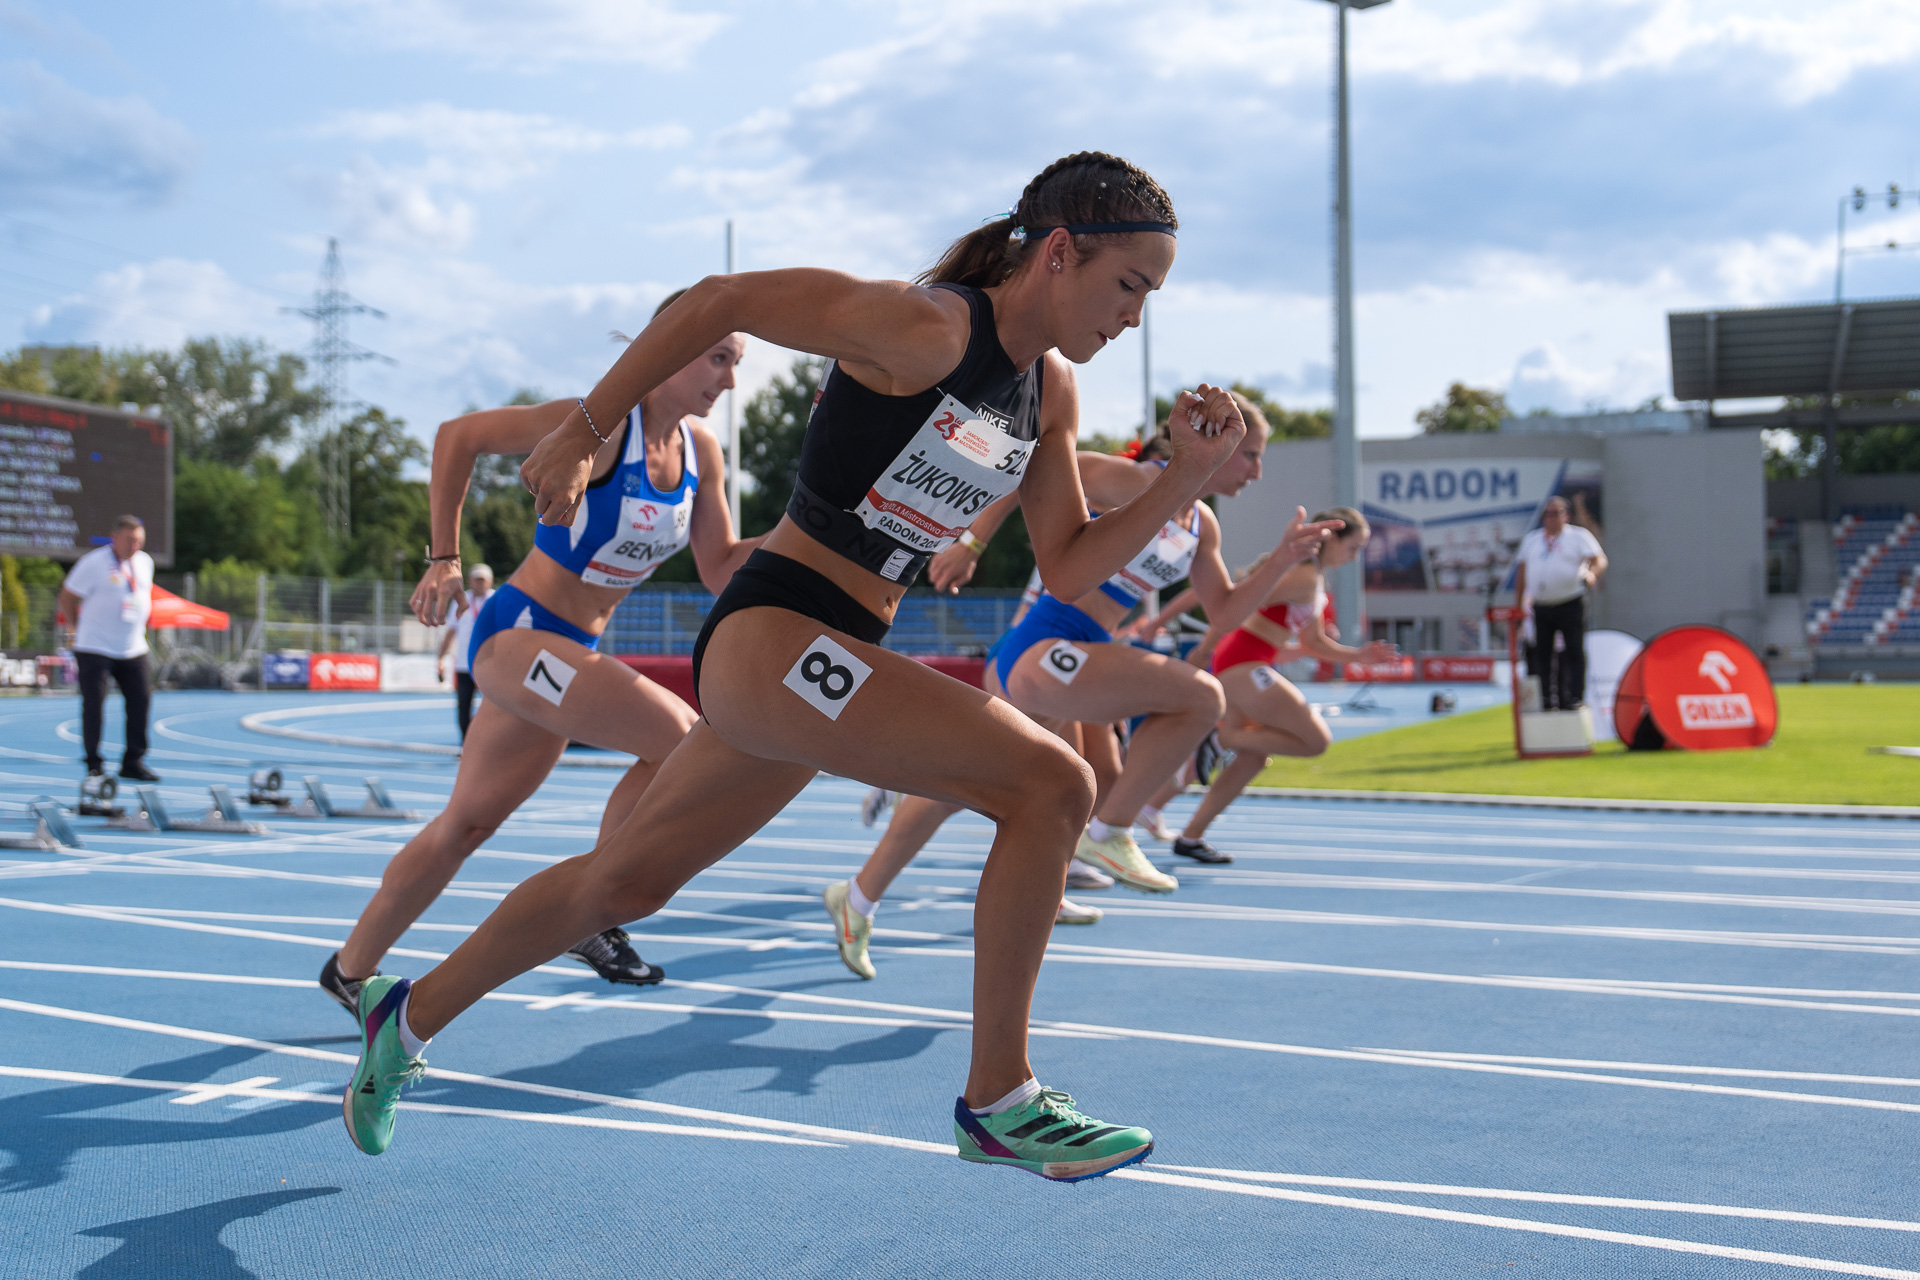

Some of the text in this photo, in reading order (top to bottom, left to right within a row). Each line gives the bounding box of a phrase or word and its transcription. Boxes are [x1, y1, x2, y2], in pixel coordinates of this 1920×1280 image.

[976, 407, 1009, 433] NIKE
[1378, 469, 1519, 500] RADOM
[632, 521, 656, 532] ORLEN
[878, 516, 922, 544] RADOM
[899, 507, 942, 536] Mistrzostwa
[1050, 648, 1079, 673] 6
[530, 659, 563, 693] 7
[801, 651, 854, 701] 8
[1684, 701, 1748, 722] ORLEN
